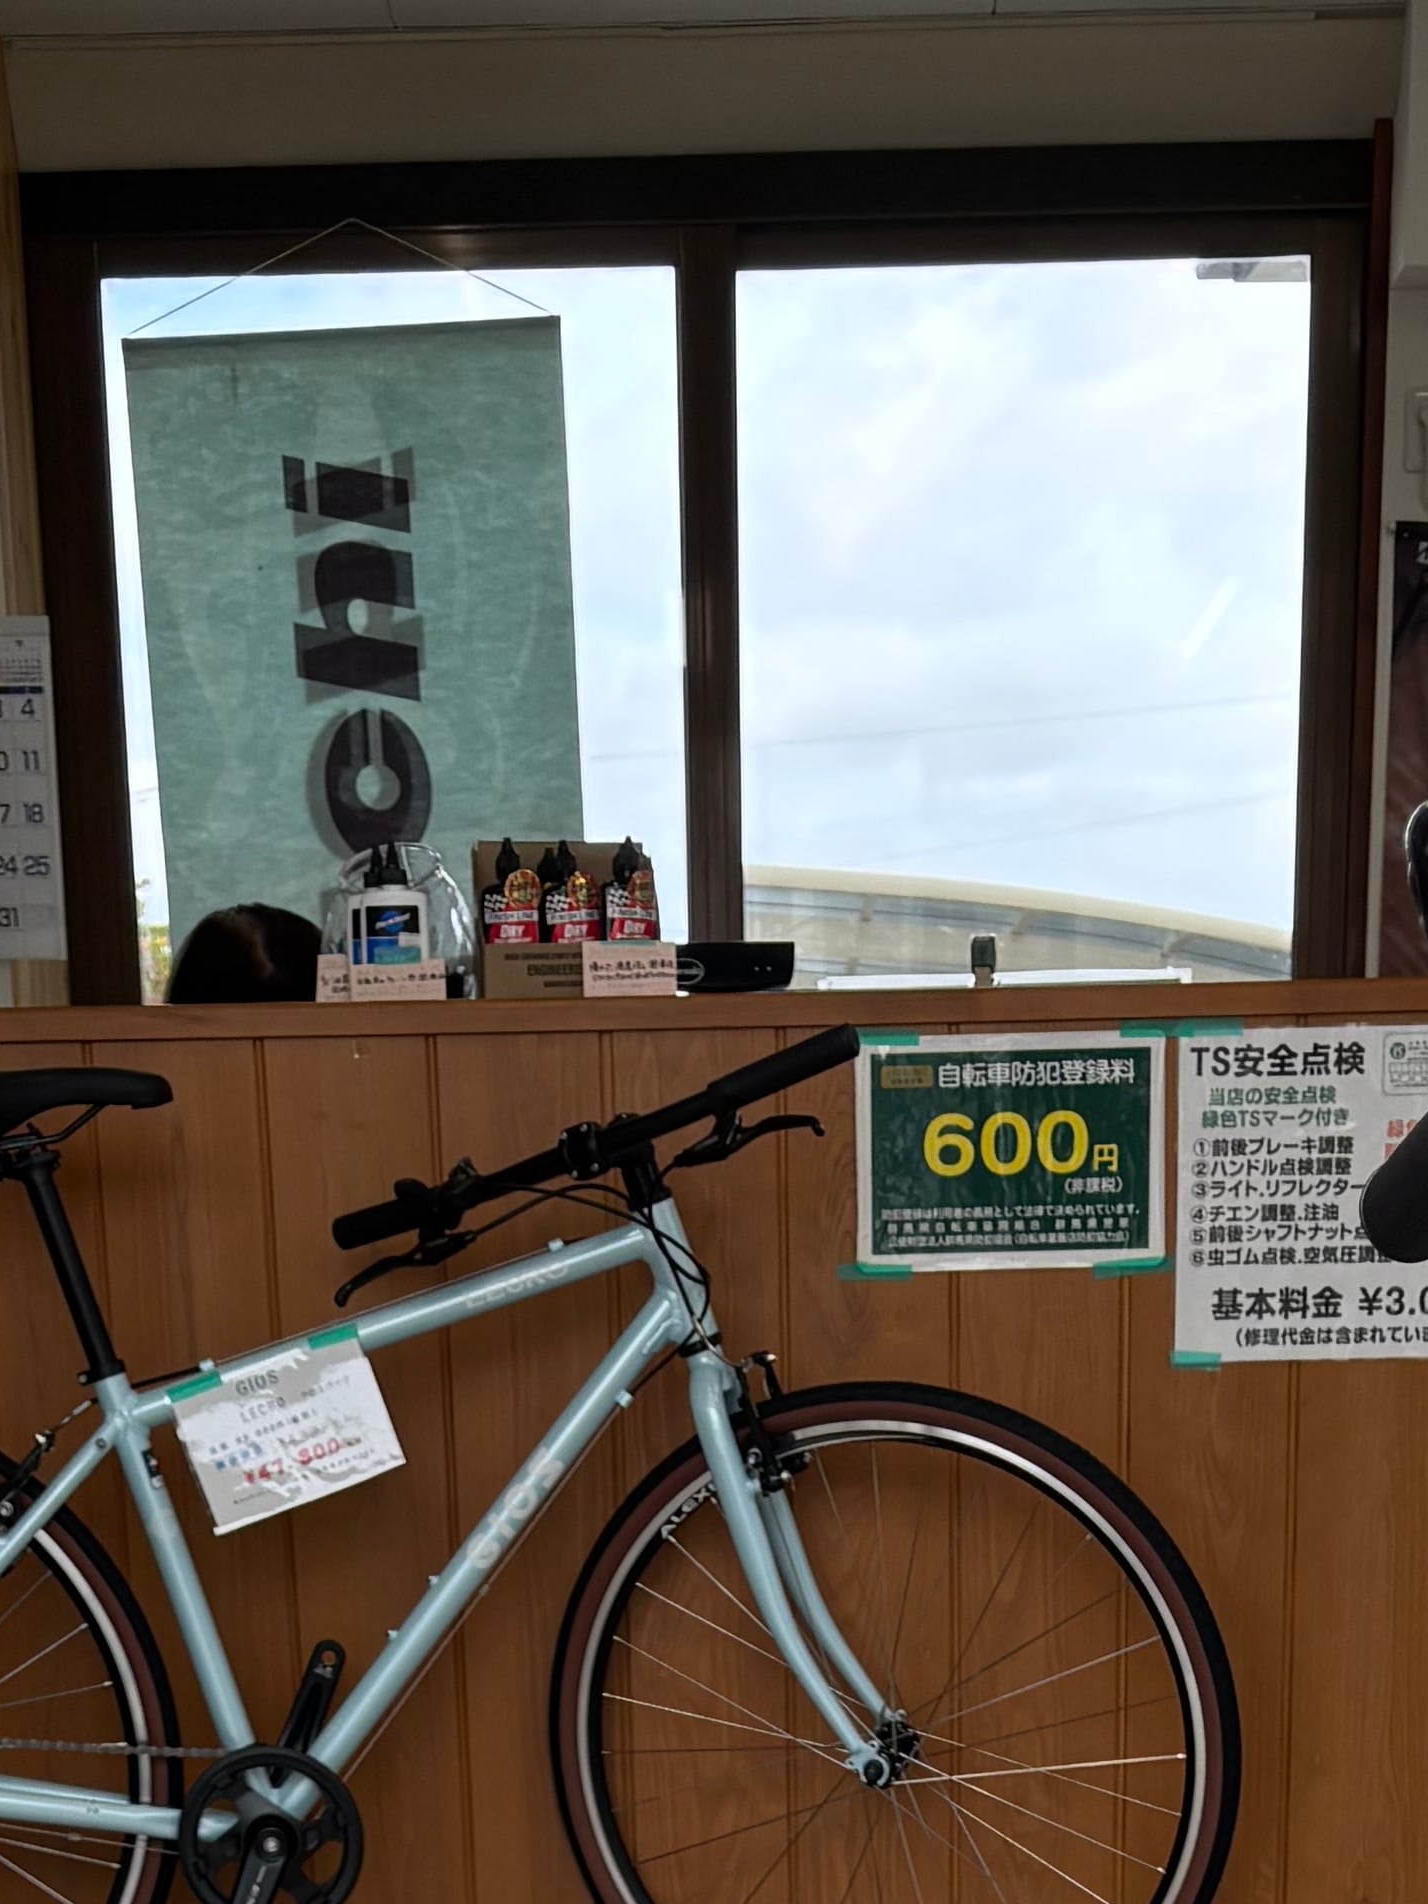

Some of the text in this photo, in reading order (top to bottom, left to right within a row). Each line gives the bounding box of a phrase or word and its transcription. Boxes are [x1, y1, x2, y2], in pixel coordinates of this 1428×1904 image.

[19, 698, 36, 719] 4
[21, 751, 40, 772] 11
[23, 803, 45, 825] 18
[24, 855, 51, 877] 25
[1190, 1042, 1366, 1077] TS安全点検
[938, 1058, 1135, 1088] 自転車防犯登録料
[1208, 1086, 1337, 1106] 当店の安全点検
[1202, 1108, 1350, 1129] 緑色TSマーク付き
[923, 1110, 1119, 1177] 600円
[1211, 1286, 1343, 1321] 基本料金
[235, 1369, 279, 1397] GIOS
